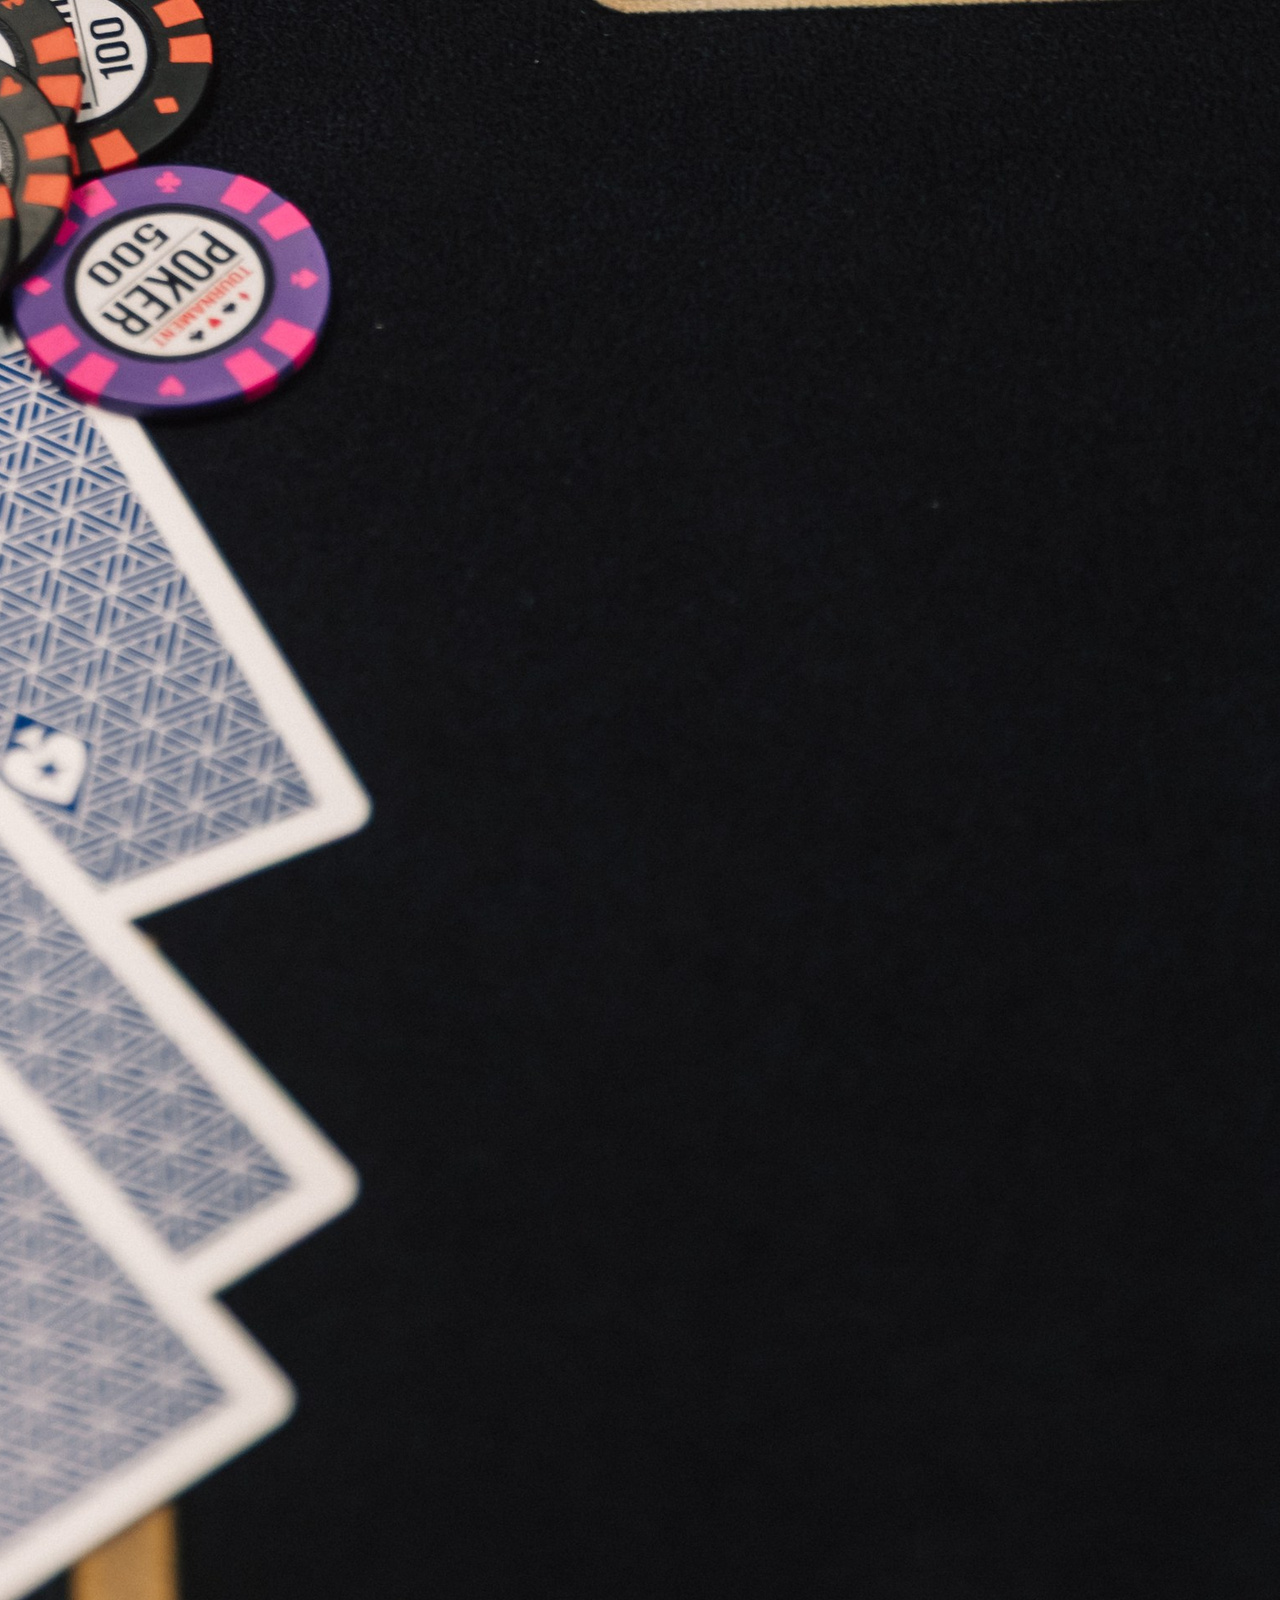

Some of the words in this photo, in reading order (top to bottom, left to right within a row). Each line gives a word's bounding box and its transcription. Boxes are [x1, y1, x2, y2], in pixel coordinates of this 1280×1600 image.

[90, 17, 134, 80] 100
[87, 223, 169, 286] 500
[104, 230, 237, 338] POKER
[154, 266, 252, 348] TOURNAMENT
